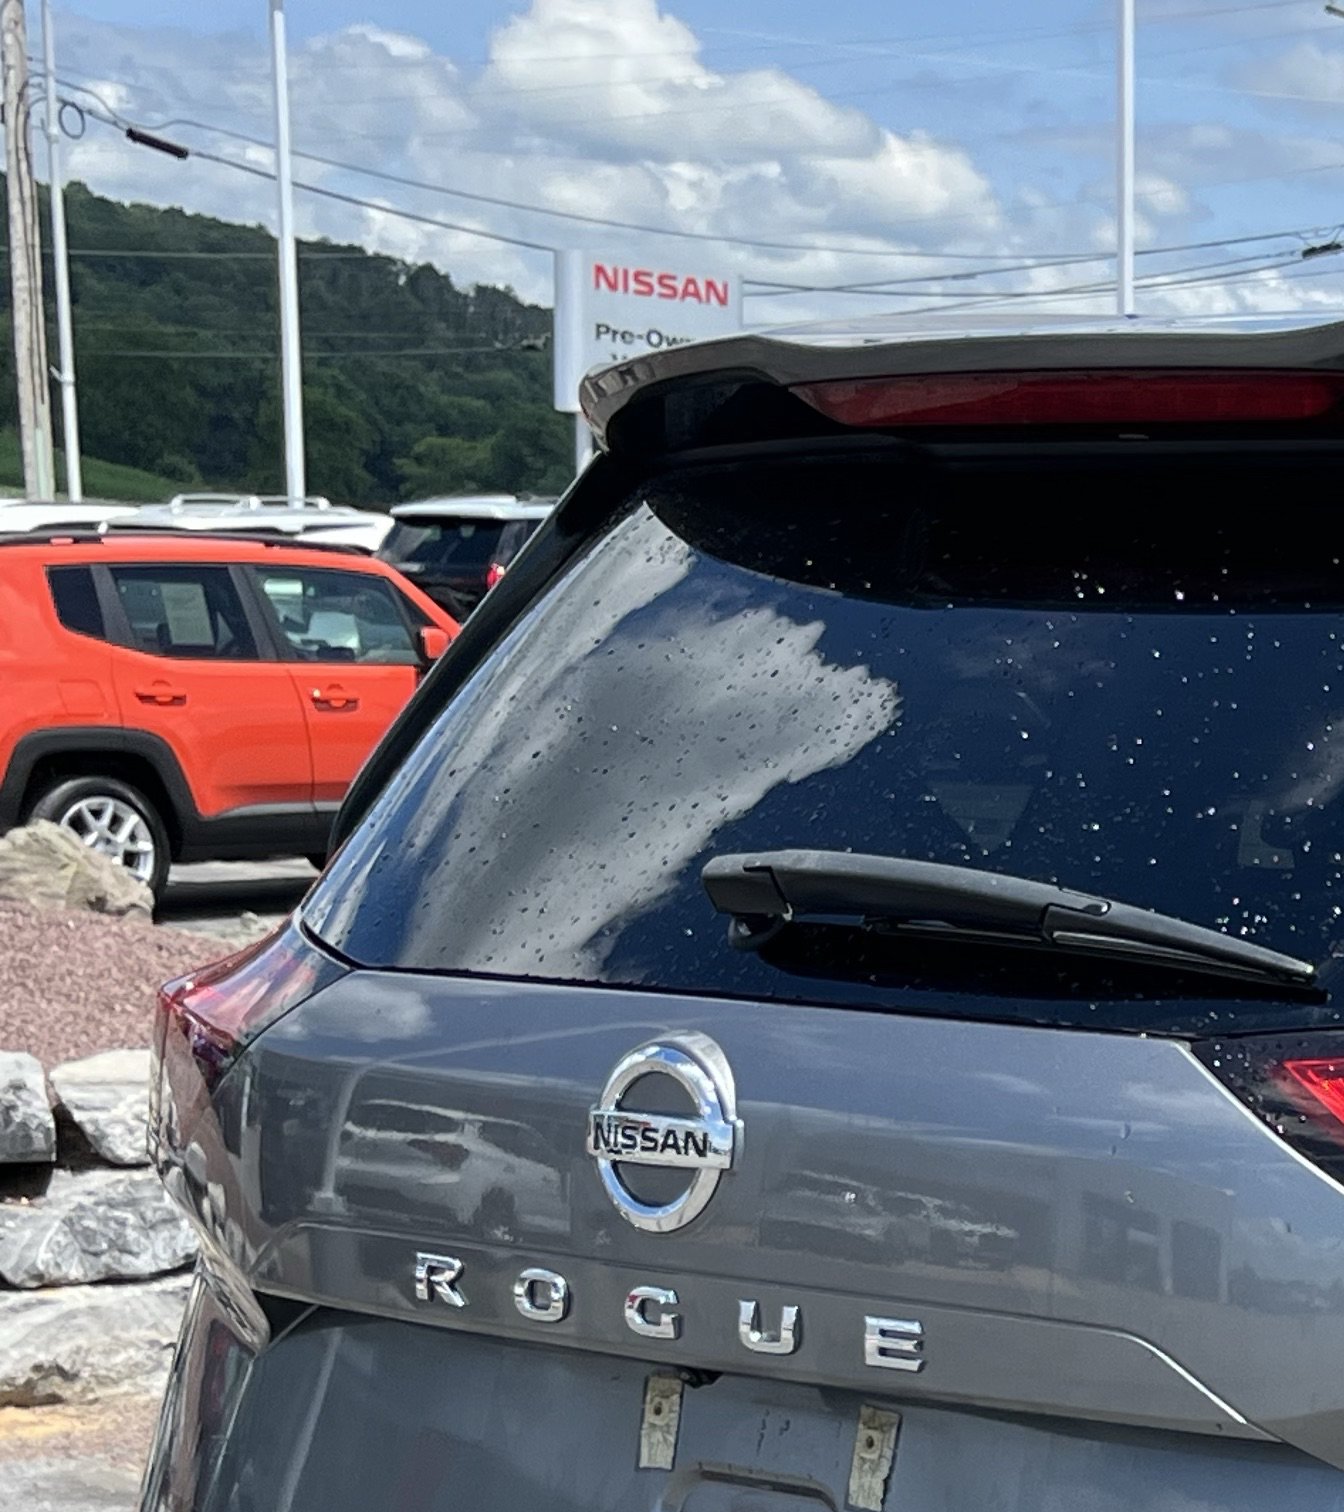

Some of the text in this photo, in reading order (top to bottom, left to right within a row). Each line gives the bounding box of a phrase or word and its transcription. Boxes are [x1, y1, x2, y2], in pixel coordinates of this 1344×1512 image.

[593, 264, 728, 306] NISSAN
[595, 322, 696, 348] Pre-Ow
[592, 1119, 710, 1159] NISSAN
[413, 1250, 926, 1373] ROGUE
